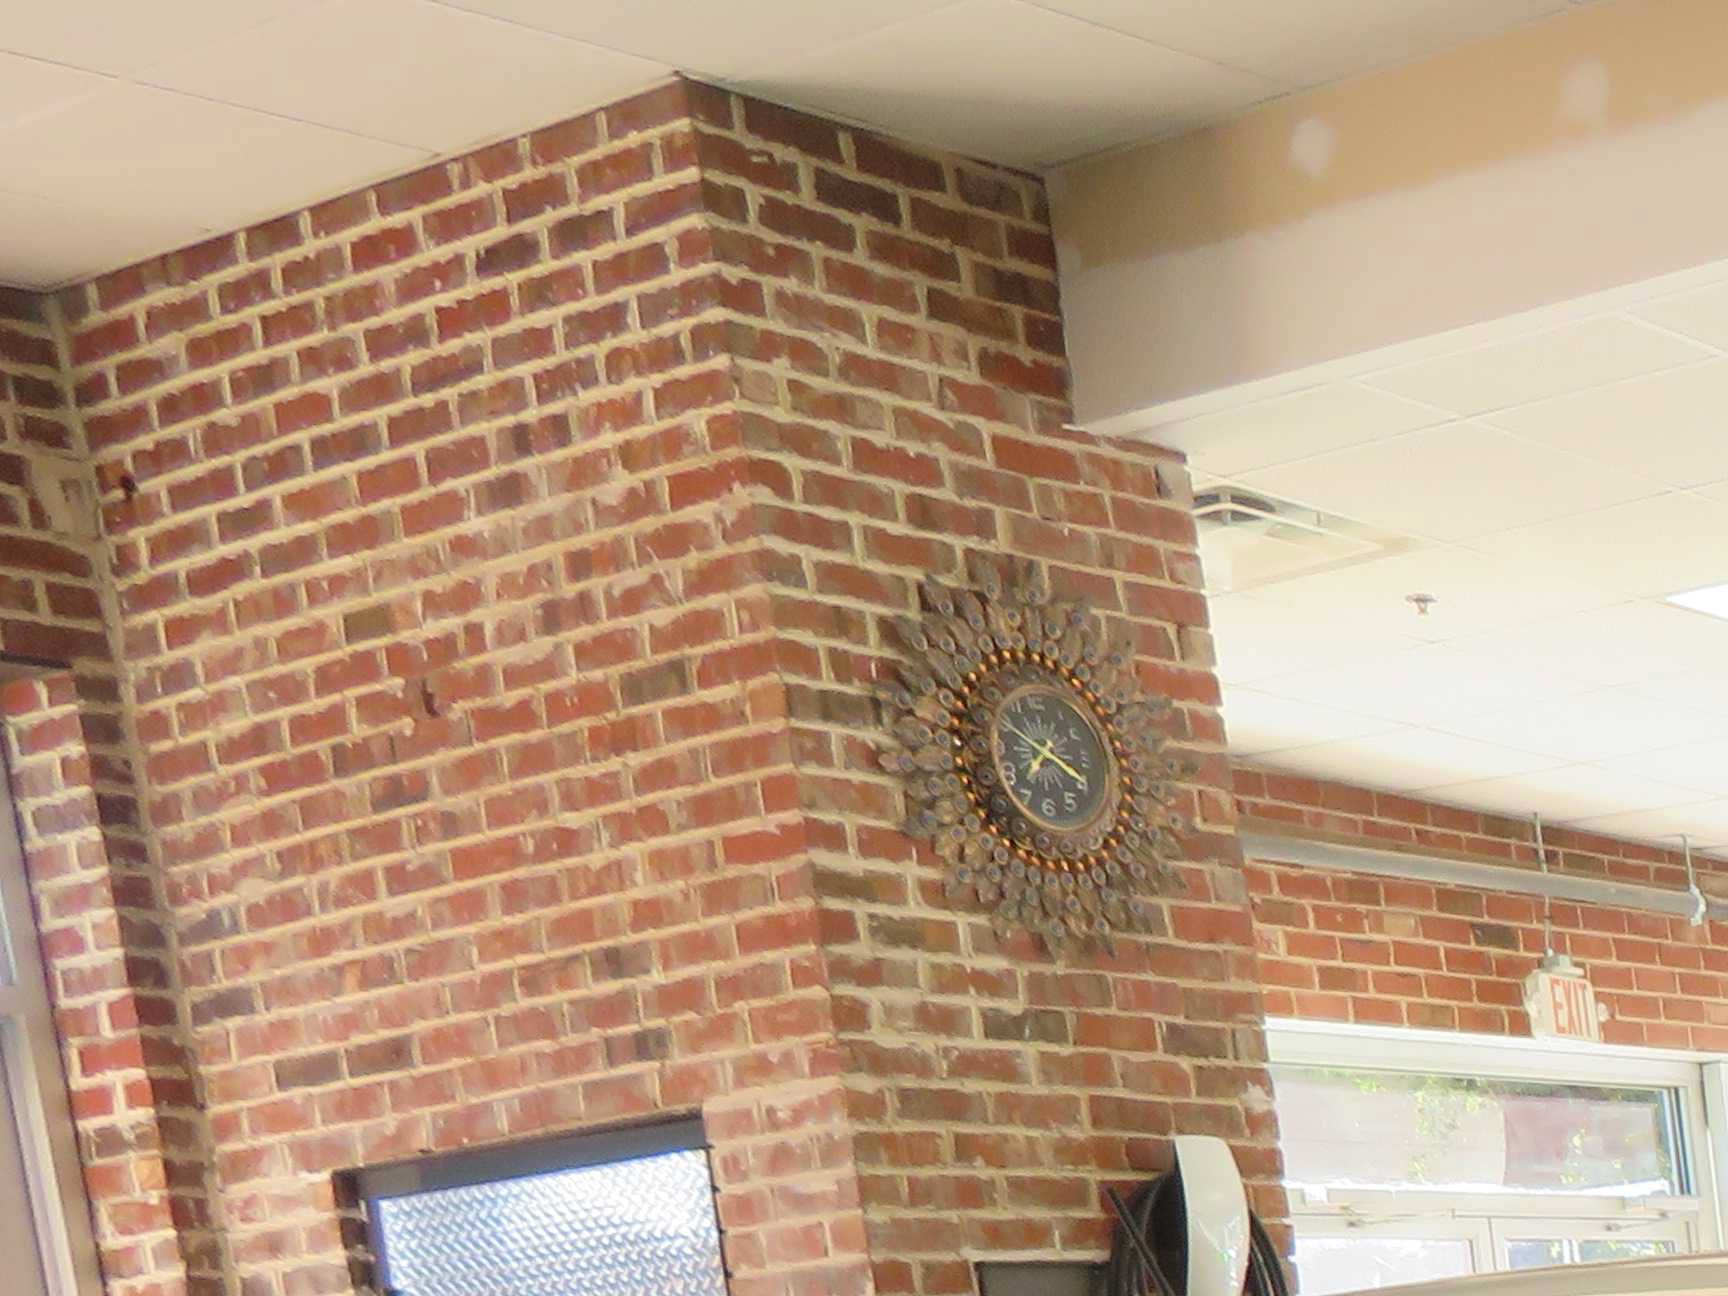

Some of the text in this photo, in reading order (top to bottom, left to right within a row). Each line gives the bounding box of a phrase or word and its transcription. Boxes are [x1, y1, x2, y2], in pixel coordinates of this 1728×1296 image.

[1041, 798, 1056, 817] 6
[1063, 791, 1077, 813] 5
[1551, 977, 1592, 1036] EXIT
